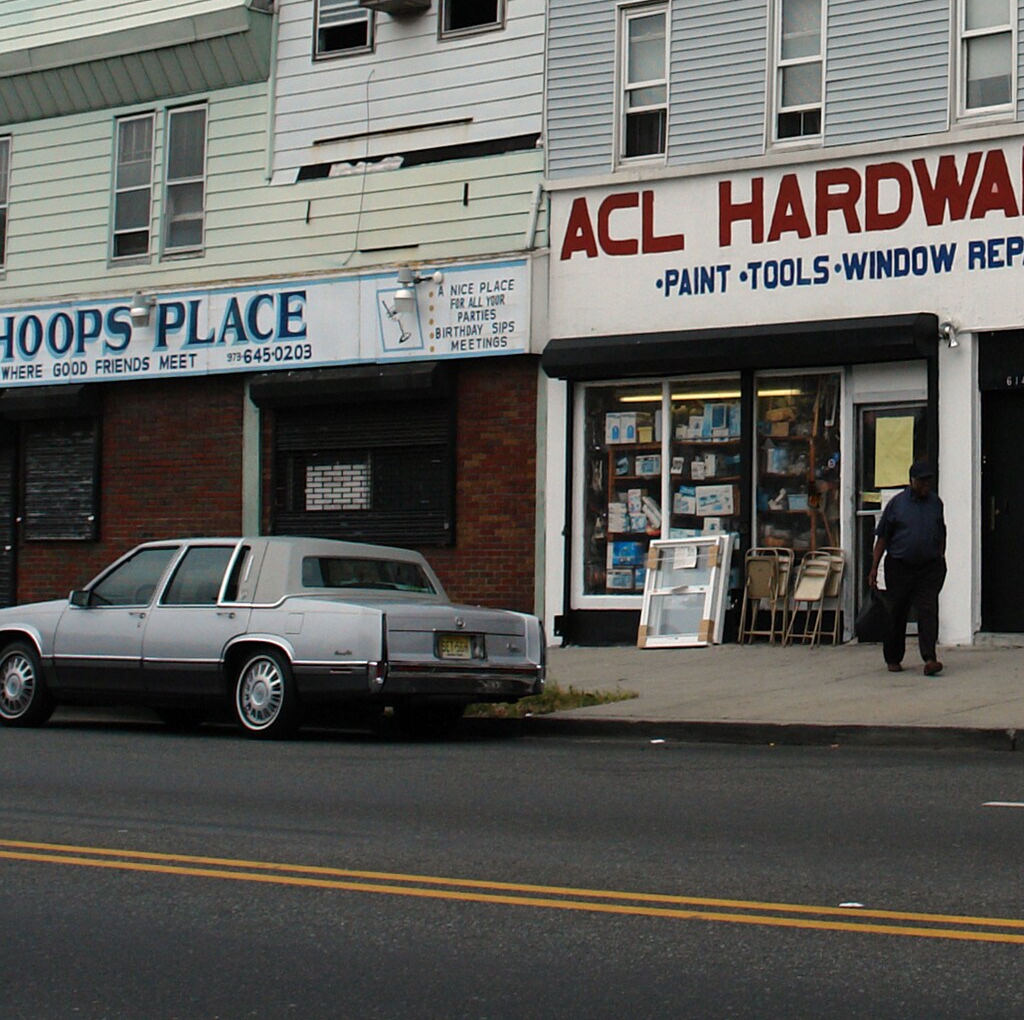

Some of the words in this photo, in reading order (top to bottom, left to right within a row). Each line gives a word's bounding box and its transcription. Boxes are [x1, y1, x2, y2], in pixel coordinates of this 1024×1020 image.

[560, 189, 685, 261] ACL
[664, 264, 731, 297] PAINT
[746, 255, 831, 289] TOOLS
[842, 243, 957, 280] WINDOW
[438, 284, 444, 297] A
[450, 282, 474, 296] NICE
[480, 278, 515, 294] PLACE
[450, 297, 465, 310] FOR
[468, 296, 483, 309] ALL
[486, 293, 506, 307] YOUR
[153, 290, 307, 351] PLACE
[458, 308, 497, 323] PARTIES
[435, 324, 483, 340] BIRTHDAY
[492, 321, 515, 335] SIPS
[451, 336, 508, 352] MEETINGS
[1, 363, 43, 380] WHERE
[53, 360, 88, 377] GOOD
[95, 356, 150, 375] FRIENDS
[159, 353, 197, 371] MEET
